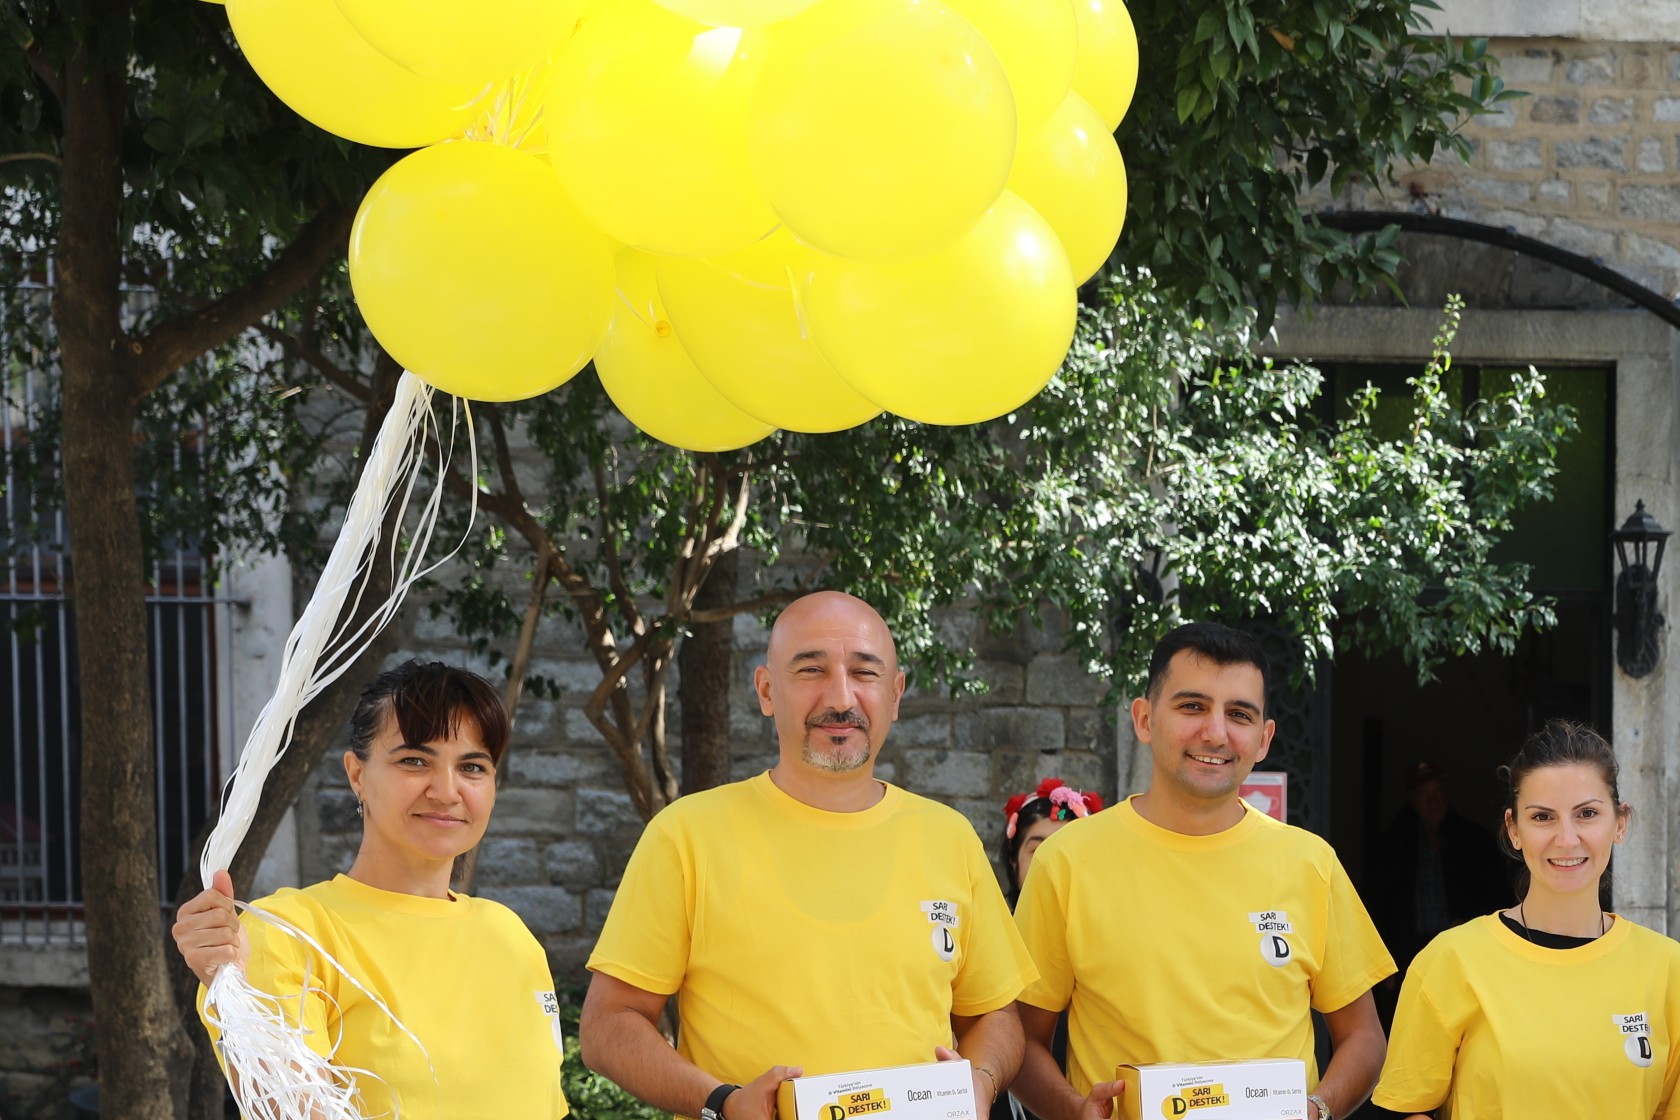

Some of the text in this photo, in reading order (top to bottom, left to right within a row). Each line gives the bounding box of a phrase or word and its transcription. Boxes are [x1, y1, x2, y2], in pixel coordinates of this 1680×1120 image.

[943, 927, 954, 953] D
[1272, 936, 1289, 958] D
[1624, 1014, 1643, 1024] SARI
[1638, 1036, 1652, 1059] D
[908, 1090, 932, 1101] Ocean
[1193, 1088, 1210, 1096] SARI
[1246, 1087, 1268, 1098] Ocean
[851, 1093, 870, 1103] SARI
[1190, 1096, 1225, 1107] DESTEK!
[848, 1101, 886, 1114] DESTEK!
[1172, 1098, 1186, 1115] D
